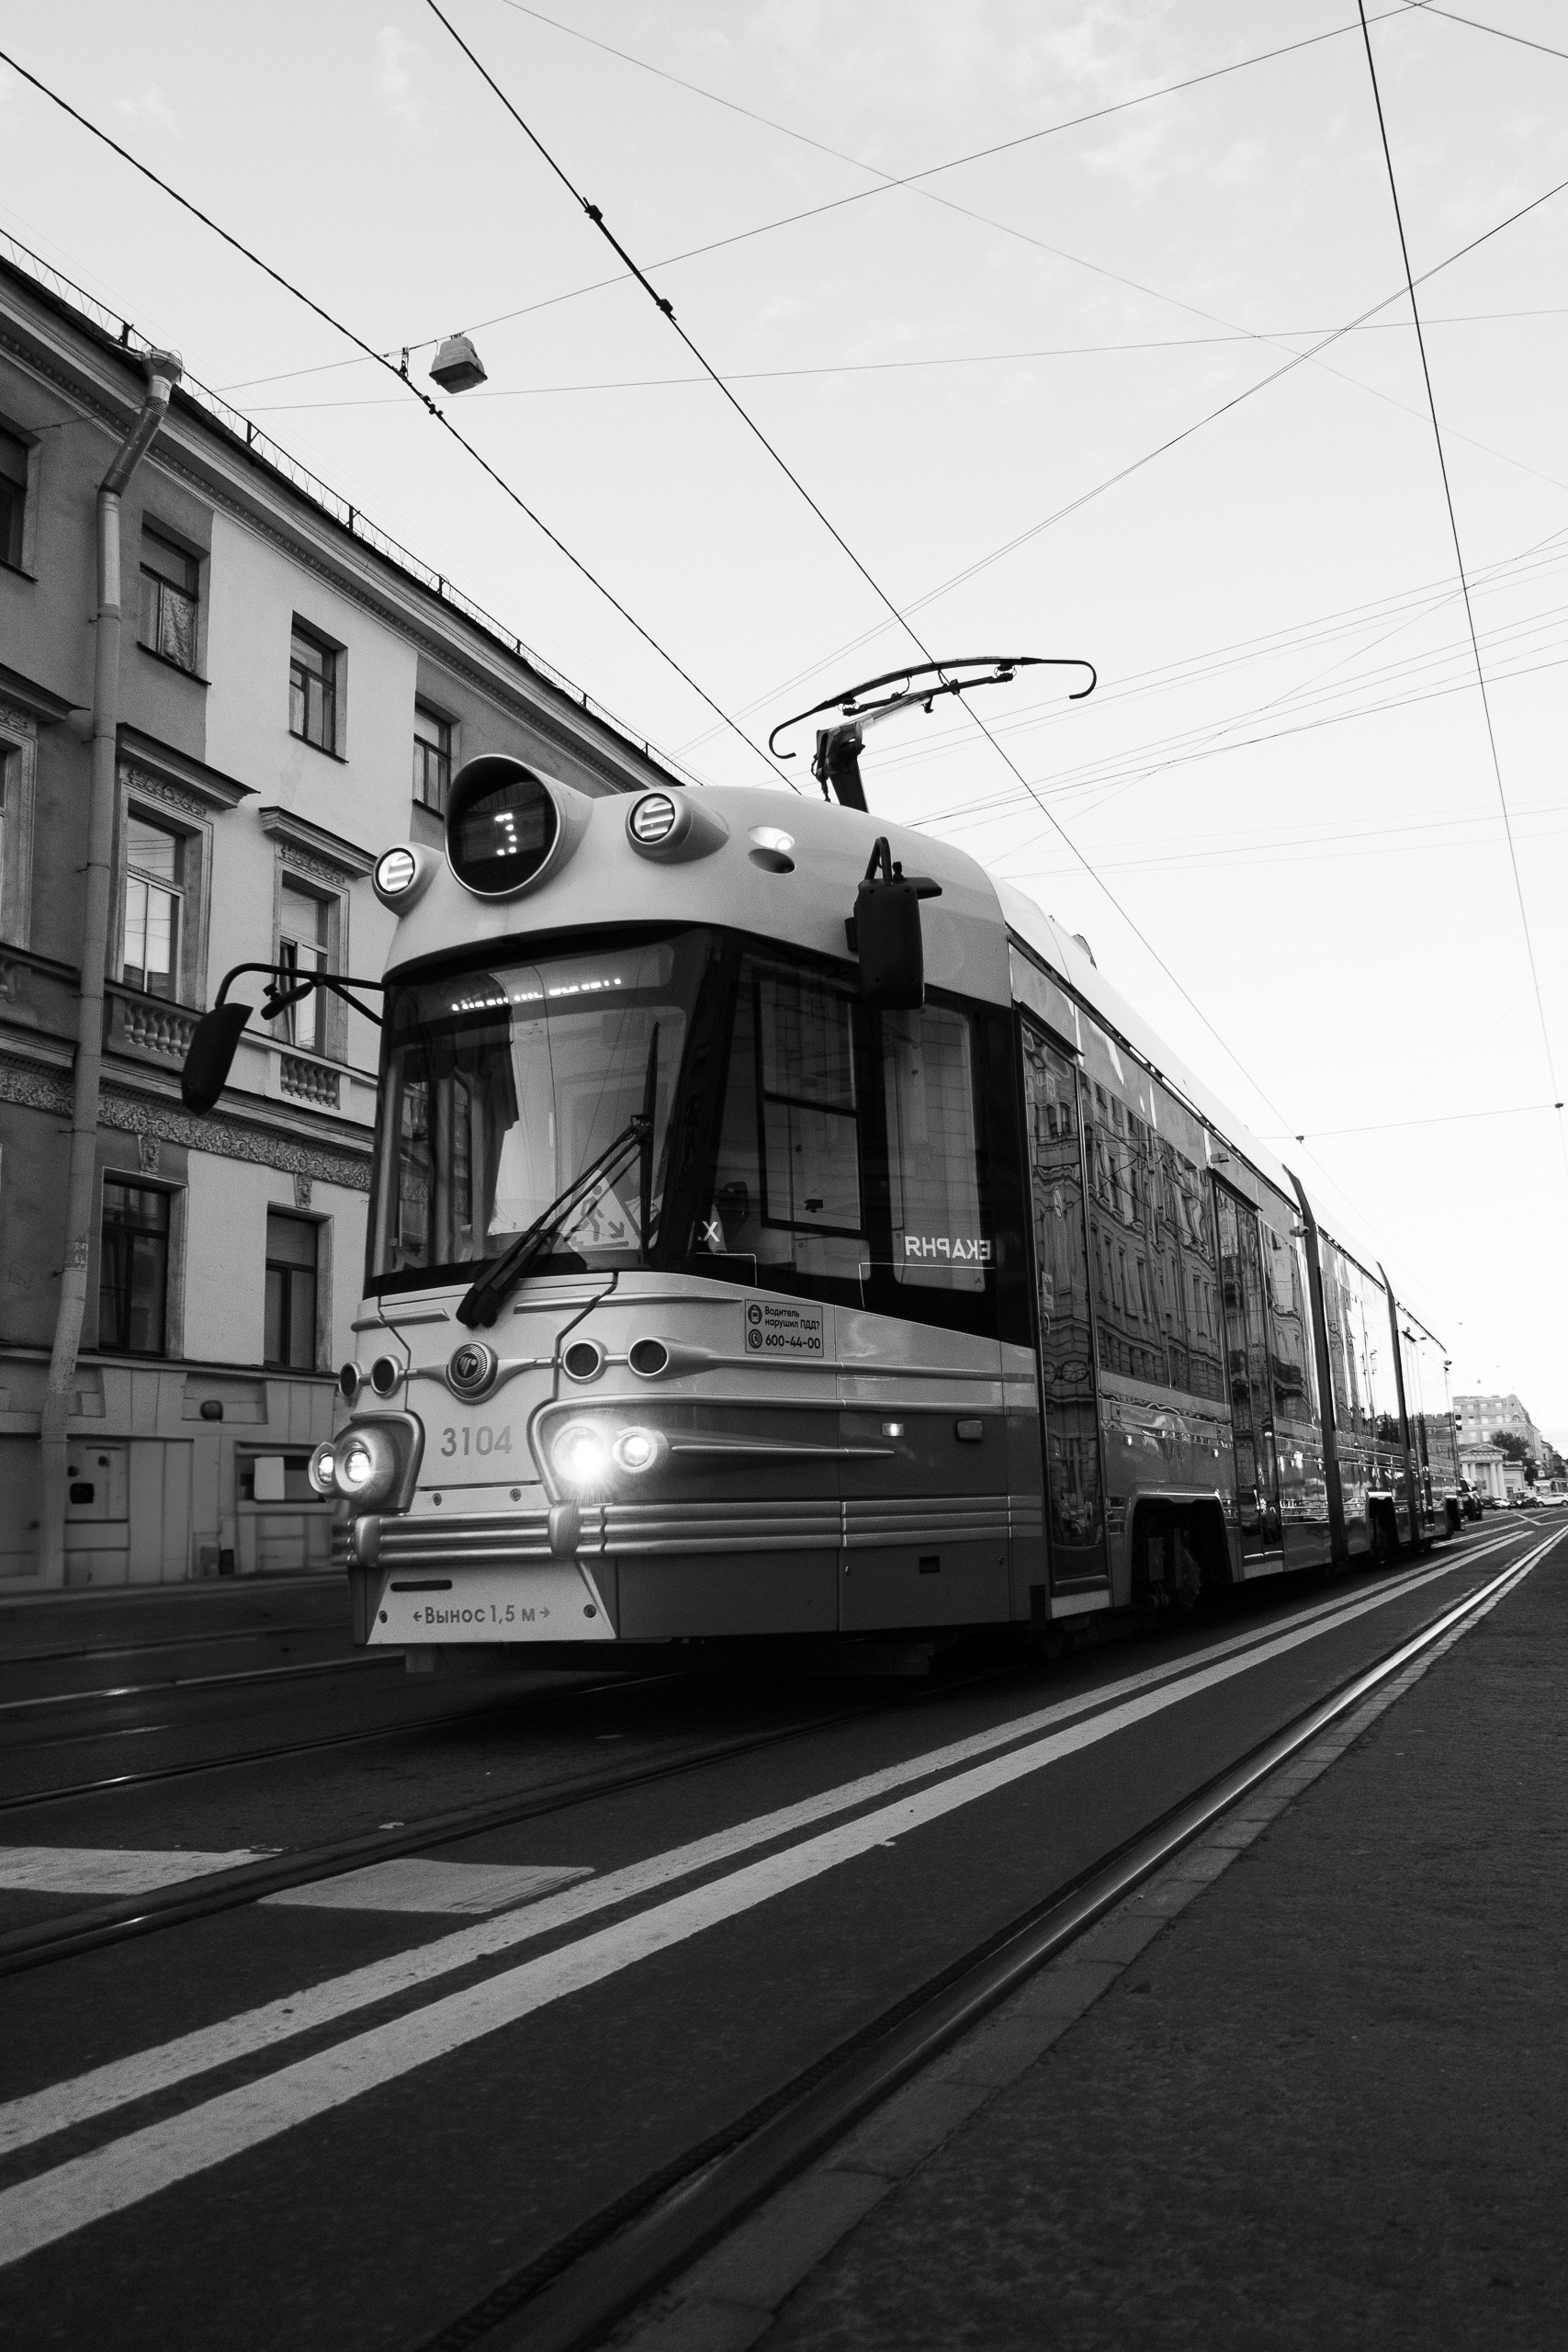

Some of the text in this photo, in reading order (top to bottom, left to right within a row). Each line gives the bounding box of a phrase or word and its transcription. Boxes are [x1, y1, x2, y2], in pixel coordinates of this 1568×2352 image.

[764, 1306, 800, 1317] Водитель
[764, 1318, 821, 1331] нарушил ПДД?
[765, 1334, 821, 1350] 600-44-00
[441, 1425, 513, 1457] 3104
[424, 1604, 536, 1624] Вынос 1,5 м
